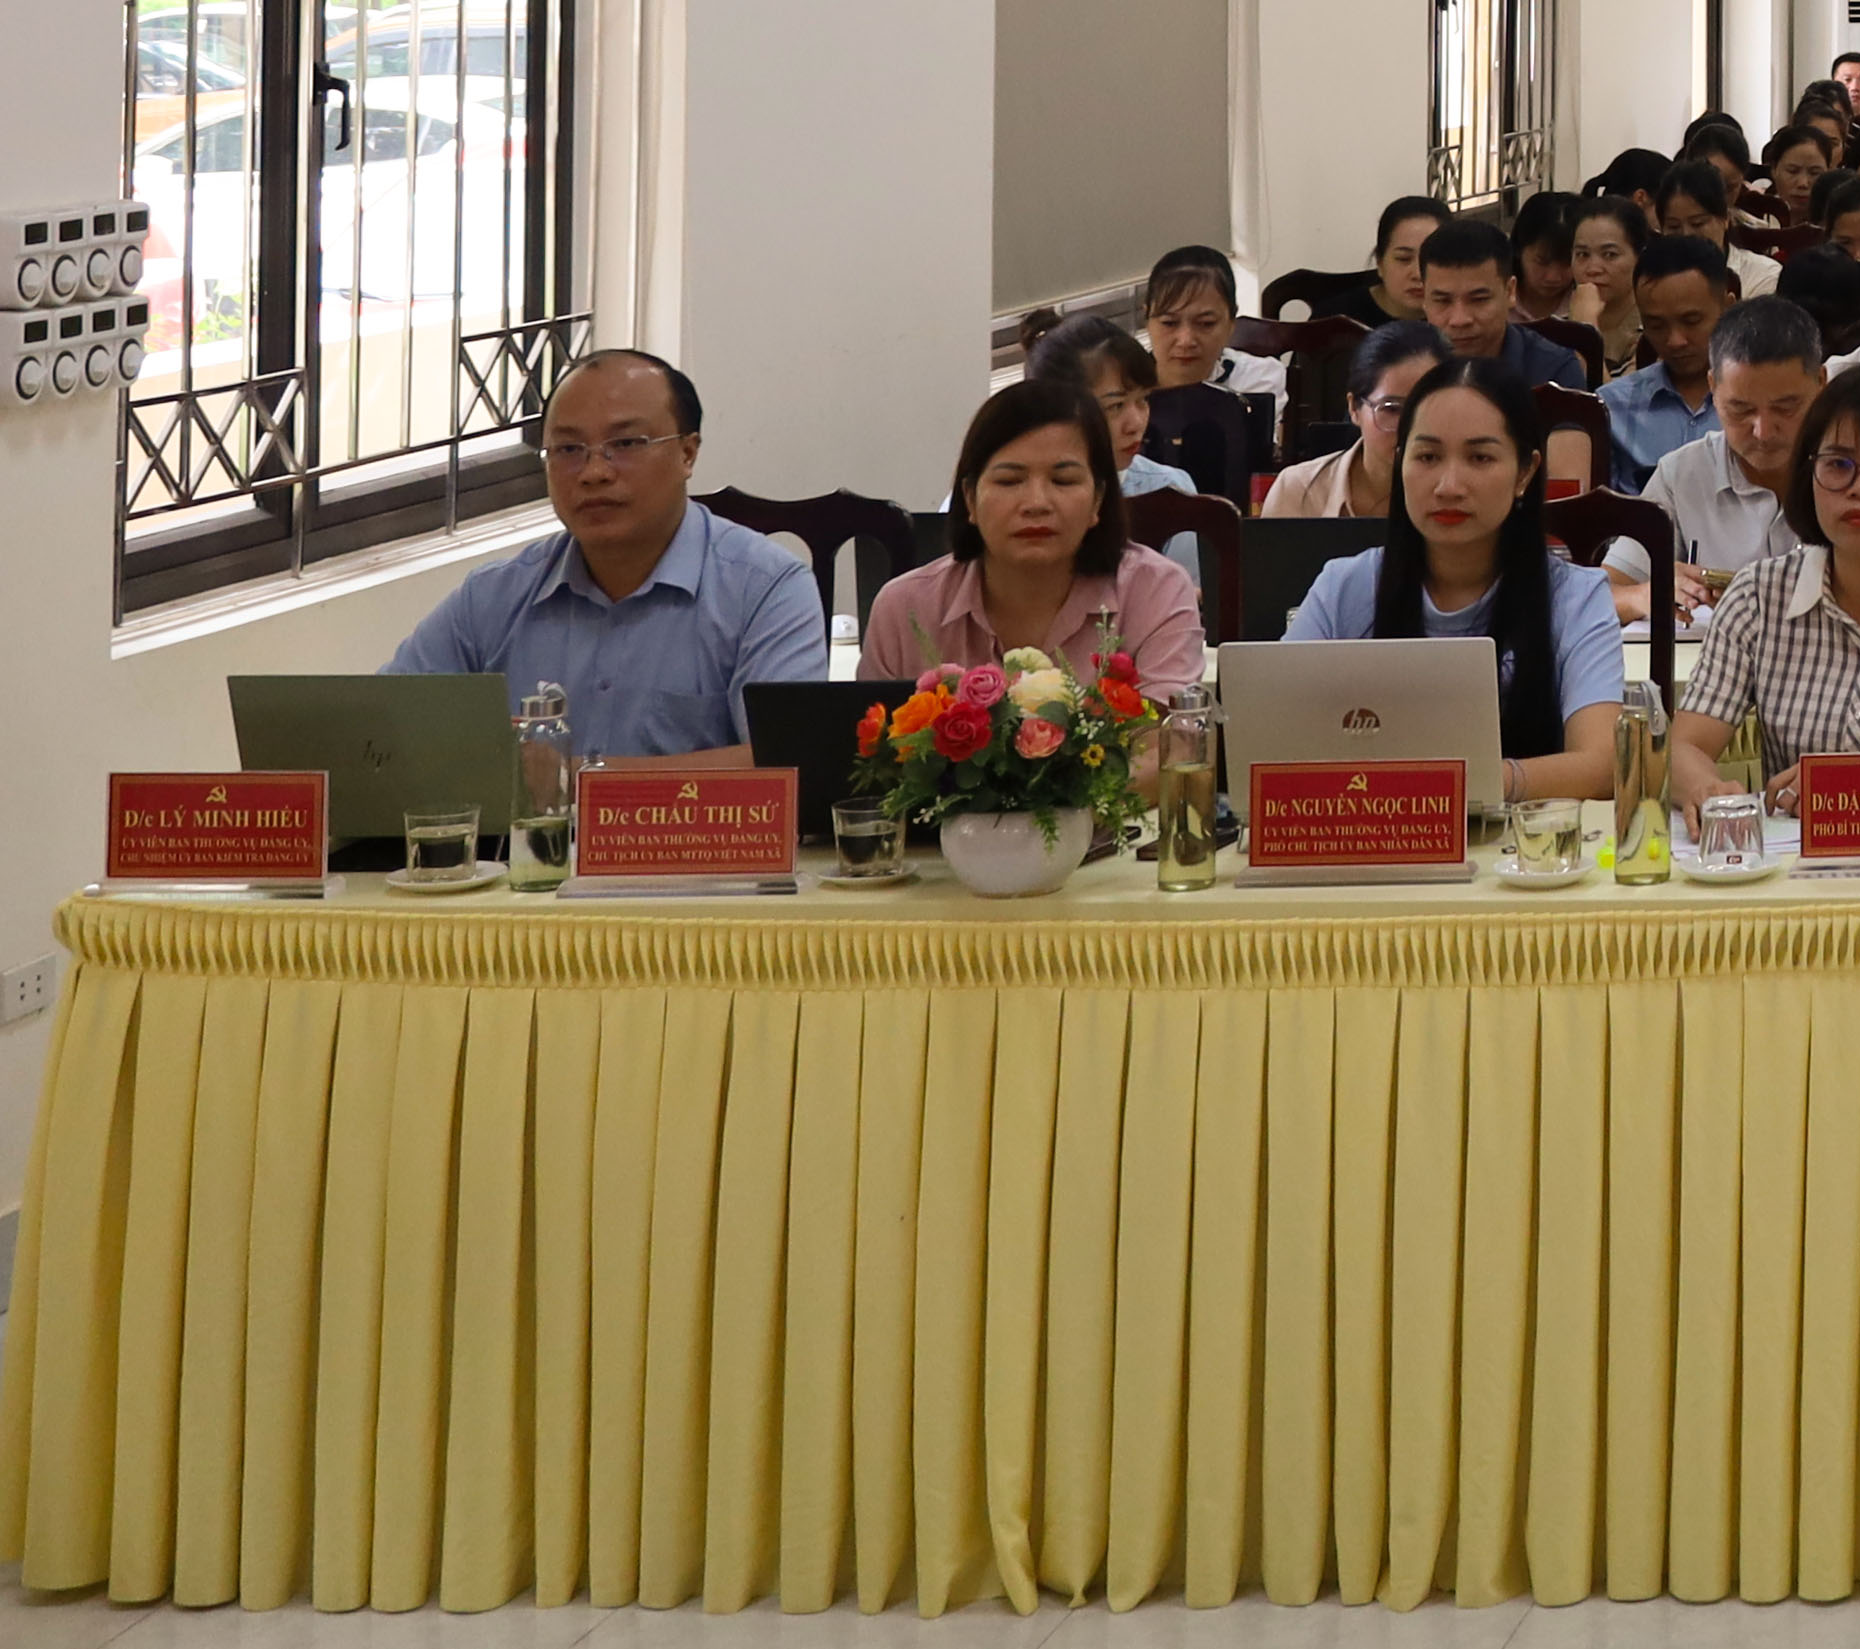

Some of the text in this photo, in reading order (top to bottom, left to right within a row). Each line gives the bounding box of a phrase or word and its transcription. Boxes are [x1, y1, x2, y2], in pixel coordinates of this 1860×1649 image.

[160, 805, 187, 828] LÝ
[193, 810, 249, 828] MINH
[1361, 797, 1407, 819] NGỌC
[1412, 796, 1450, 815] LINH
[704, 807, 742, 828] THỊ
[1813, 820, 1835, 836] PHÓ
[1837, 818, 1848, 835] BÍ
[638, 833, 660, 845] BAN
[1310, 824, 1332, 836] BAN
